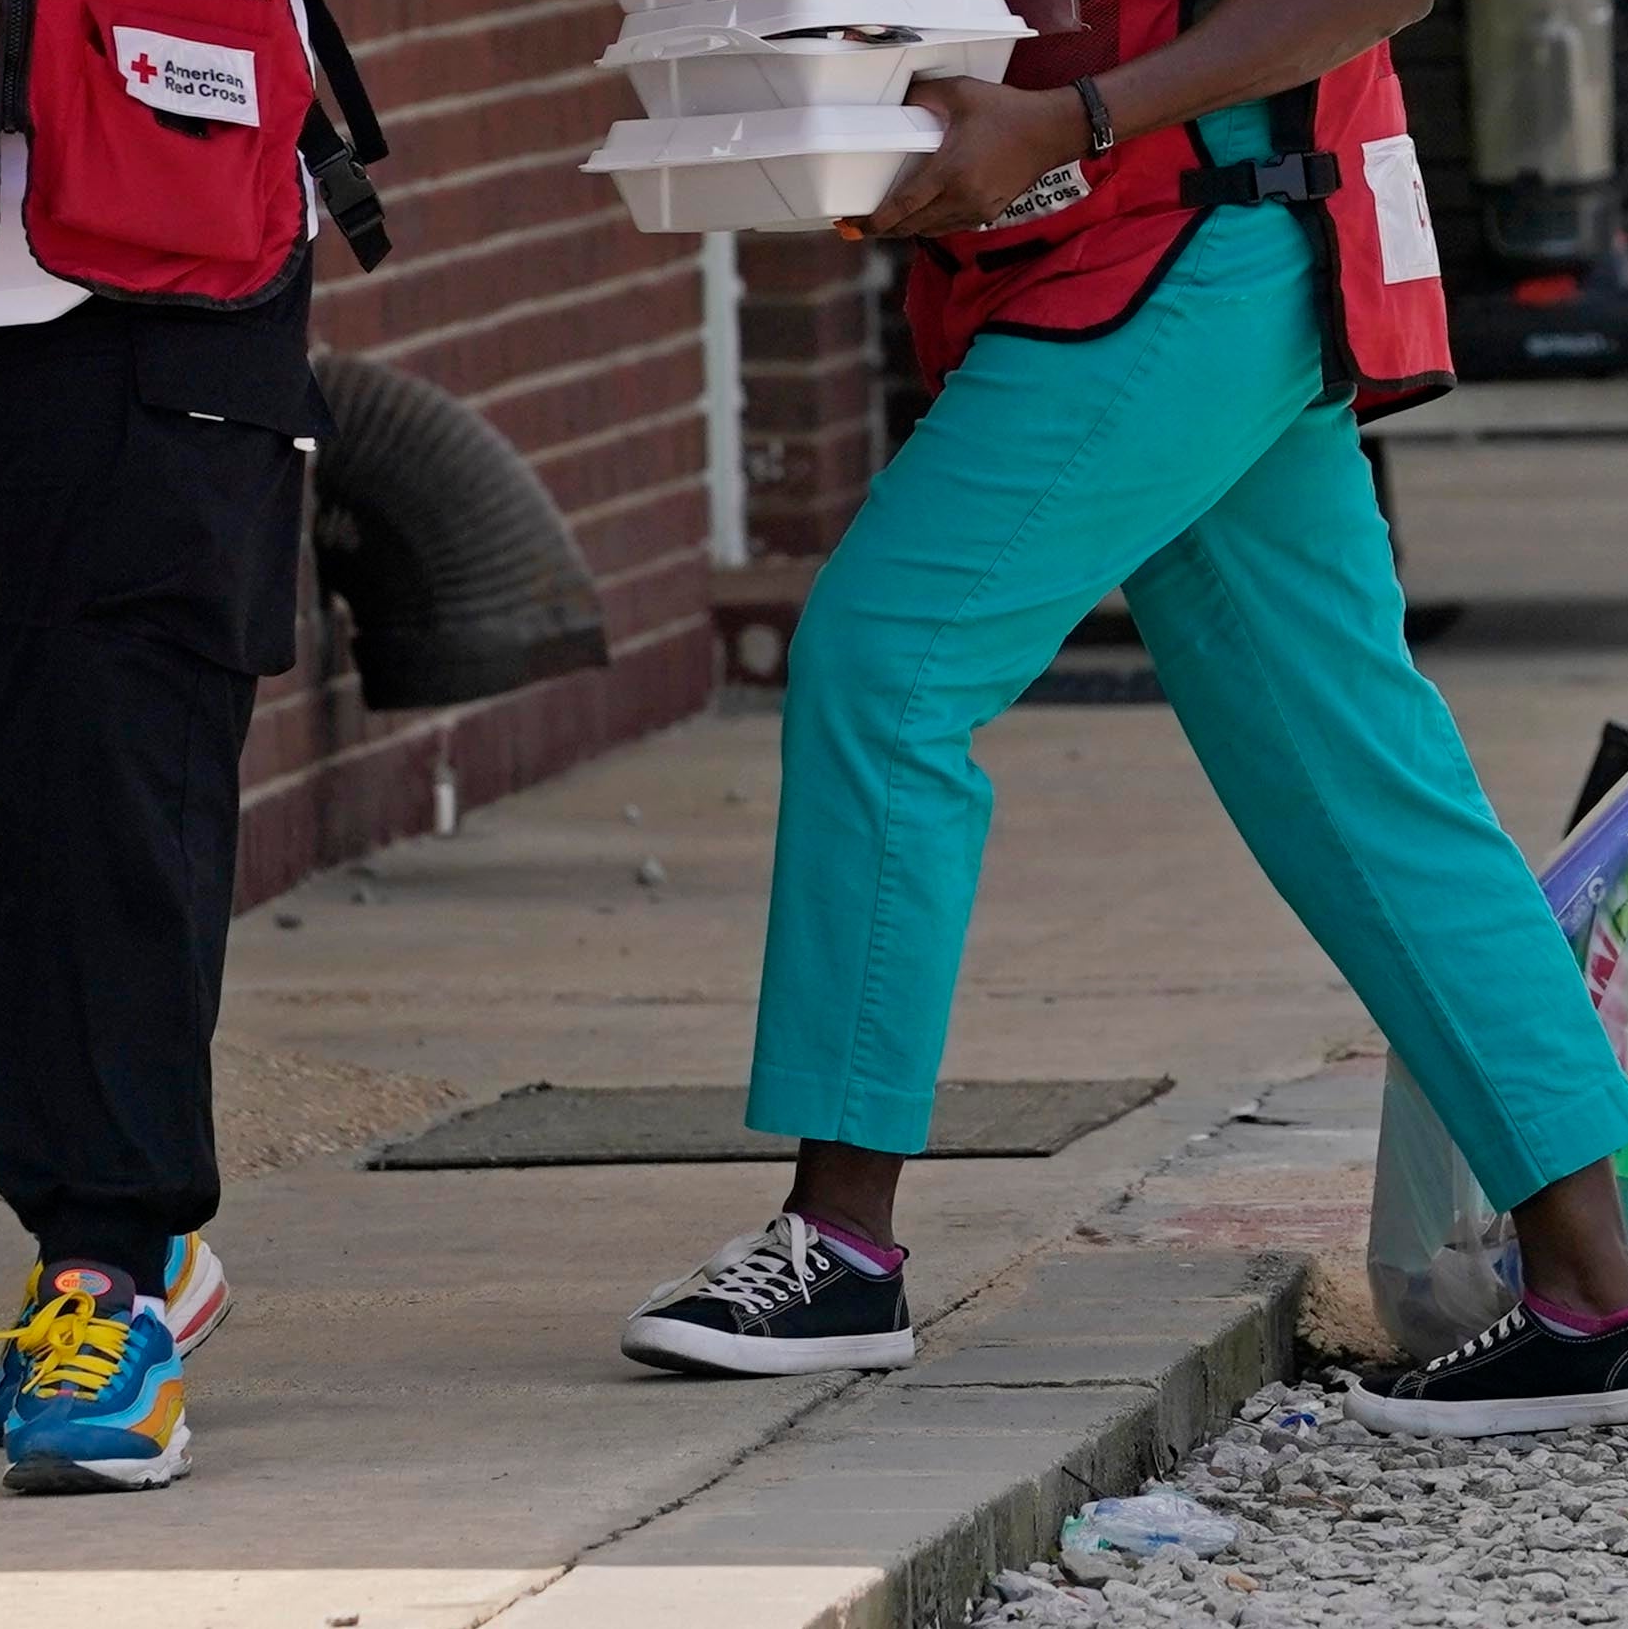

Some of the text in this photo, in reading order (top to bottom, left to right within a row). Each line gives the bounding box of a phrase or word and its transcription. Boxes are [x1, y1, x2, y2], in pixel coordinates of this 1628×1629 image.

[165, 60, 244, 89] American
[165, 76, 247, 105] Red Cross
[1005, 185, 1080, 219] Red Cross
